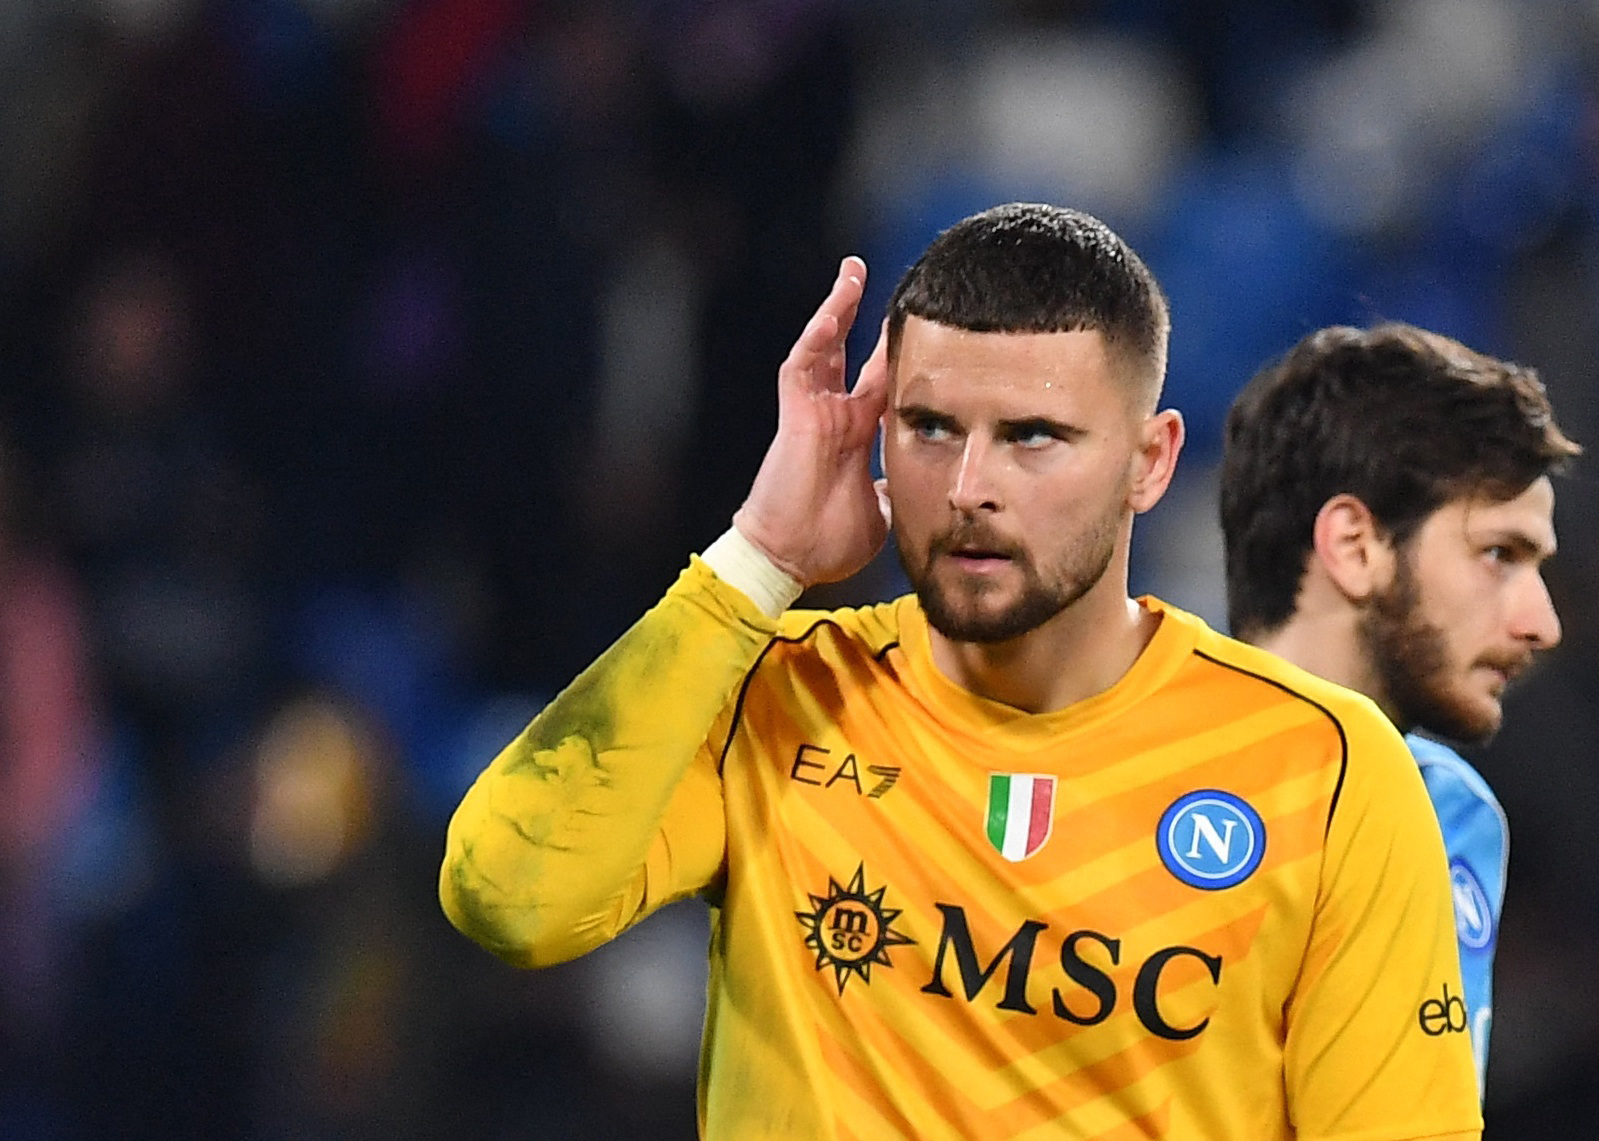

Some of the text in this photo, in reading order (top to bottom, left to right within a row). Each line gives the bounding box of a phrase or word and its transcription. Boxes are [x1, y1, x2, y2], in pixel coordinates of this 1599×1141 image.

[790, 744, 901, 799] EA7
[1186, 812, 1239, 865] N
[921, 901, 1223, 1041] MSC
